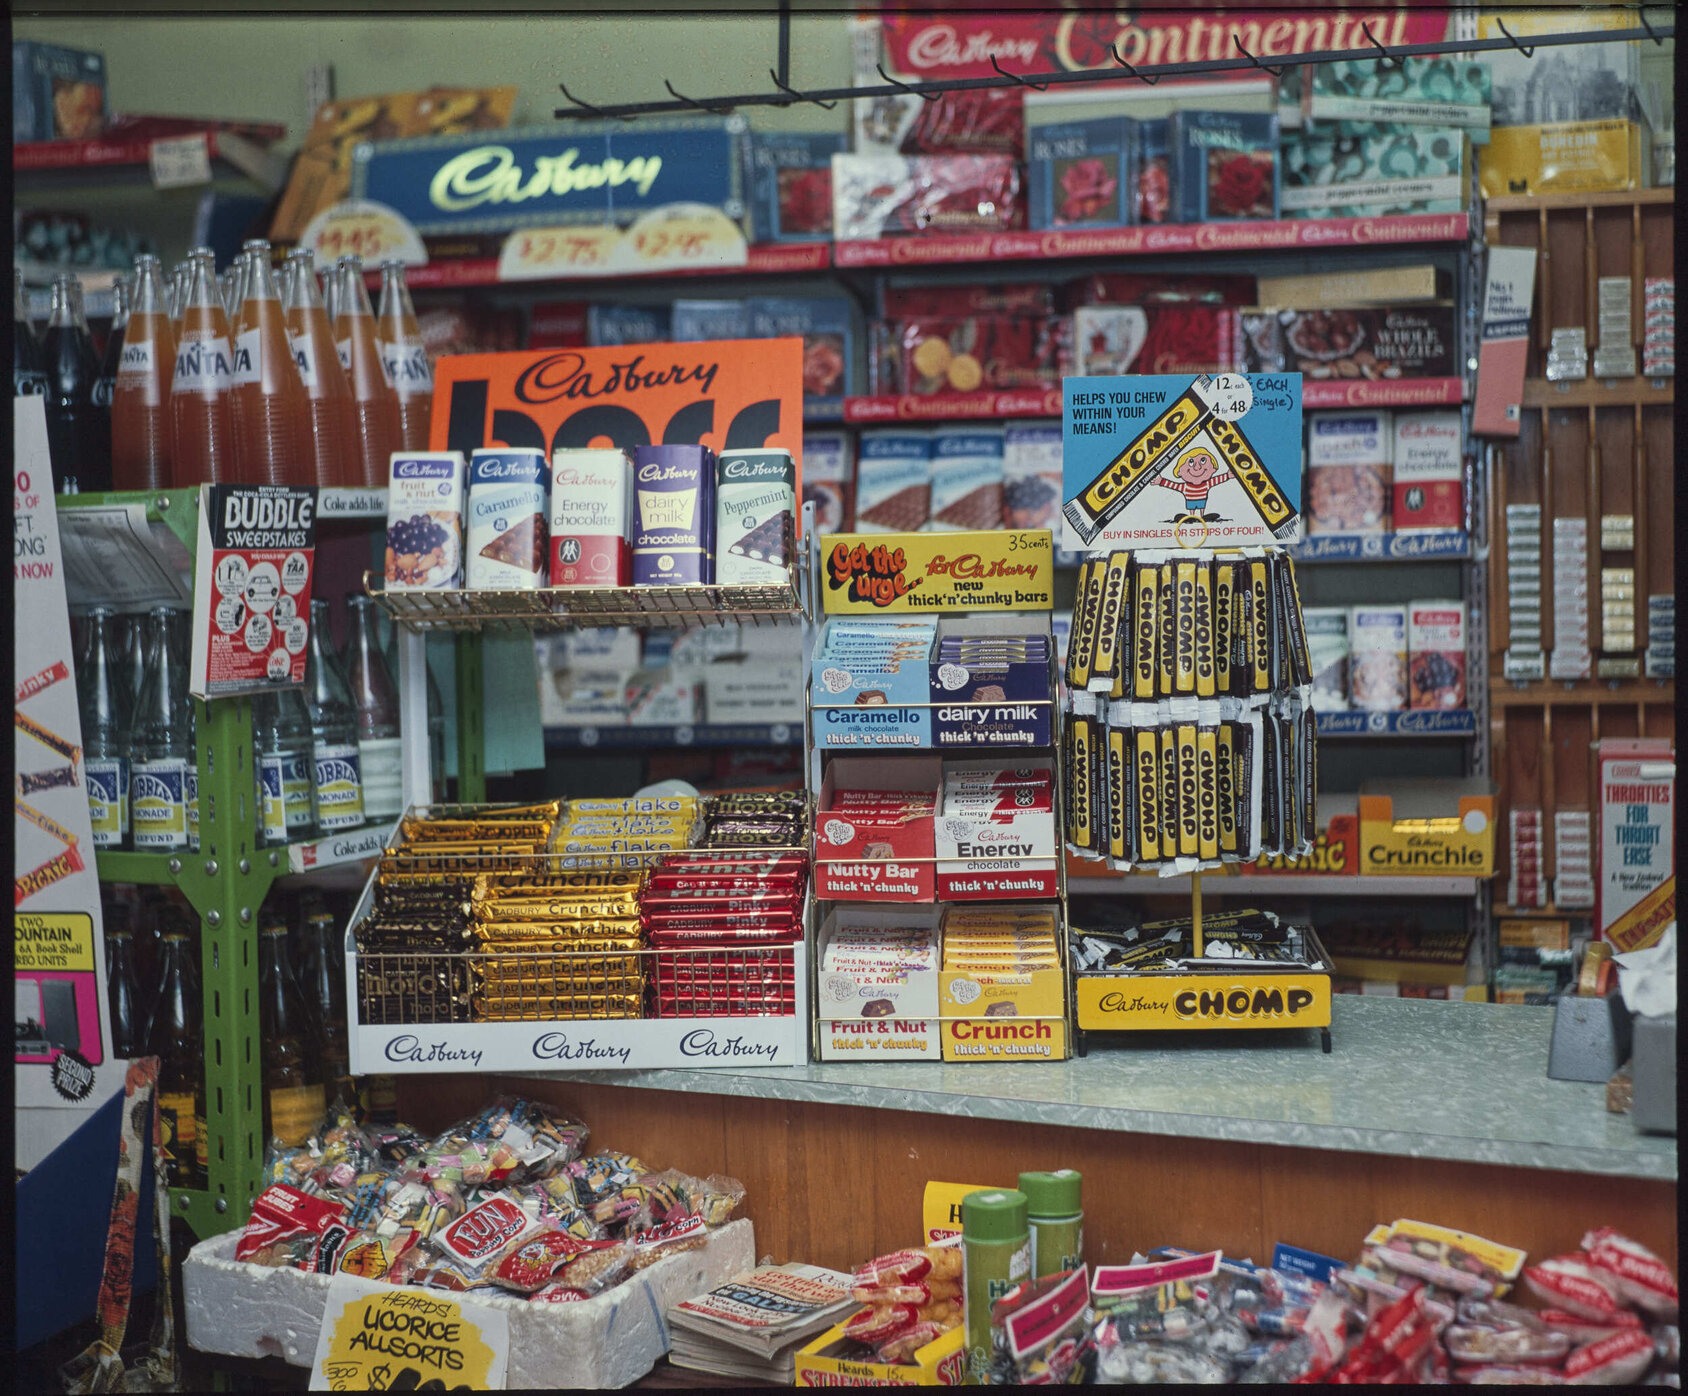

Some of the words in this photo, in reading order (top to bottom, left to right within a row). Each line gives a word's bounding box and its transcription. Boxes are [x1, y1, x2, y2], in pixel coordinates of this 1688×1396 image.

[907, 24, 1038, 66] Cadbury
[1054, 9, 1410, 72] Continental
[429, 145, 662, 212] Cadbury
[1196, 225, 1299, 249] Continental
[1352, 217, 1456, 247] Continental
[515, 353, 719, 404] Cadbury
[1073, 393, 1106, 405] HELPS
[1109, 392, 1131, 405] YOU
[1134, 391, 1166, 404] CHEW
[1073, 408, 1112, 420] WITHIN
[1117, 406, 1145, 418] YOUR
[1212, 402, 1220, 414] 4
[1073, 422, 1117, 435] MEANS!
[1096, 410, 1186, 500] CHOMP
[399, 461, 449, 478] Cadbury
[477, 458, 542, 479] Cadbury
[637, 463, 698, 483] Cadbury
[725, 459, 788, 478] Cadbury
[1210, 419, 1282, 513] CHOMP
[556, 467, 617, 489] Cadbury
[323, 498, 346, 512] Coke
[348, 499, 369, 511] adds
[370, 499, 385, 511] life
[475, 491, 541, 518] Caramello
[562, 499, 609, 516] Energy
[645, 495, 689, 511] dairy
[723, 488, 788, 516] Peppermint
[224, 496, 314, 530] BUBBLE
[554, 512, 617, 528] chocolate
[649, 510, 685, 523] milk
[226, 530, 306, 548] SWEEPSTAKES
[638, 533, 697, 545] chocolate
[1103, 530, 1121, 540] BUY
[1123, 530, 1133, 539] IN
[1133, 529, 1173, 539] SINGLES
[1175, 529, 1188, 538] OR
[1189, 528, 1221, 538] STRIPS
[1223, 527, 1235, 537] OF
[1237, 526, 1265, 537] FOUR!
[1008, 534, 1028, 551] 35
[21, 562, 54, 580] NOW
[830, 542, 872, 588] Get
[872, 543, 908, 576] the
[951, 553, 1039, 580] Cadbury
[953, 580, 984, 591] new
[1138, 586, 1154, 681] CHOMP
[1178, 580, 1194, 674] CHOMP
[1216, 583, 1230, 674] CHOMP
[1255, 580, 1268, 672] CHOMP
[836, 632, 876, 640] Caramello
[826, 709, 920, 724] Caramello
[938, 706, 990, 725] dairy
[995, 705, 1038, 721] milk
[864, 725, 899, 733] chocolate
[961, 722, 1014, 731] Chocolate
[826, 732, 858, 745] thick
[876, 732, 921, 747] chunky
[940, 731, 972, 742] thick
[989, 730, 1035, 743] chunky
[1140, 750, 1157, 843] CHOMP
[1181, 744, 1197, 836] CHOMP
[1201, 750, 1215, 841] CHOMP
[1605, 784, 1670, 804] THROATIES
[959, 809, 989, 818] Energy
[1626, 804, 1649, 824] FOR
[977, 829, 1020, 842] Cadbury
[1614, 824, 1661, 846] THROAT
[333, 841, 357, 858] Coke
[358, 838, 378, 853] adds
[957, 842, 1033, 858] Energy
[1368, 845, 1483, 866] Crunchie
[1623, 847, 1652, 867] EASE
[827, 862, 881, 880] Nutty
[886, 863, 919, 879] Bar
[967, 860, 1021, 870] chocolate
[498, 873, 630, 888] Crunchie
[827, 880, 859, 892] thick
[875, 882, 919, 896] chunky
[949, 880, 981, 892] thick
[998, 878, 1045, 891] chunky
[549, 903, 626, 914] Crunchie
[19, 917, 43, 928] TWO
[550, 924, 627, 936] Crunchie
[36, 945, 58, 954] Book
[59, 944, 83, 955] Shell
[37, 954, 68, 967] UNITS
[833, 957, 851, 965] Fruit
[858, 985, 900, 1000] Cadbury
[1099, 992, 1169, 1014] Cadbury
[1175, 988, 1314, 1017] CHOMP
[831, 1021, 874, 1034] Fruit
[877, 1021, 890, 1034] &
[894, 1021, 927, 1034] Nut
[951, 1019, 1052, 1040] Crunch
[384, 1033, 483, 1066] Cadbury
[532, 1031, 632, 1064] Cadbury
[679, 1028, 779, 1062] Cadbury
[954, 1043, 987, 1056] thick
[1005, 1043, 1051, 1057] chunky
[57, 1053, 92, 1086] SECOND
[57, 1069, 84, 1099] PRIZE
[262, 1194, 296, 1213] JUBES
[269, 1186, 300, 1204] FRUIT
[453, 1203, 509, 1247] FUN
[349, 1331, 465, 1372] ALLSORTS
[837, 1362, 874, 1377] Heards
